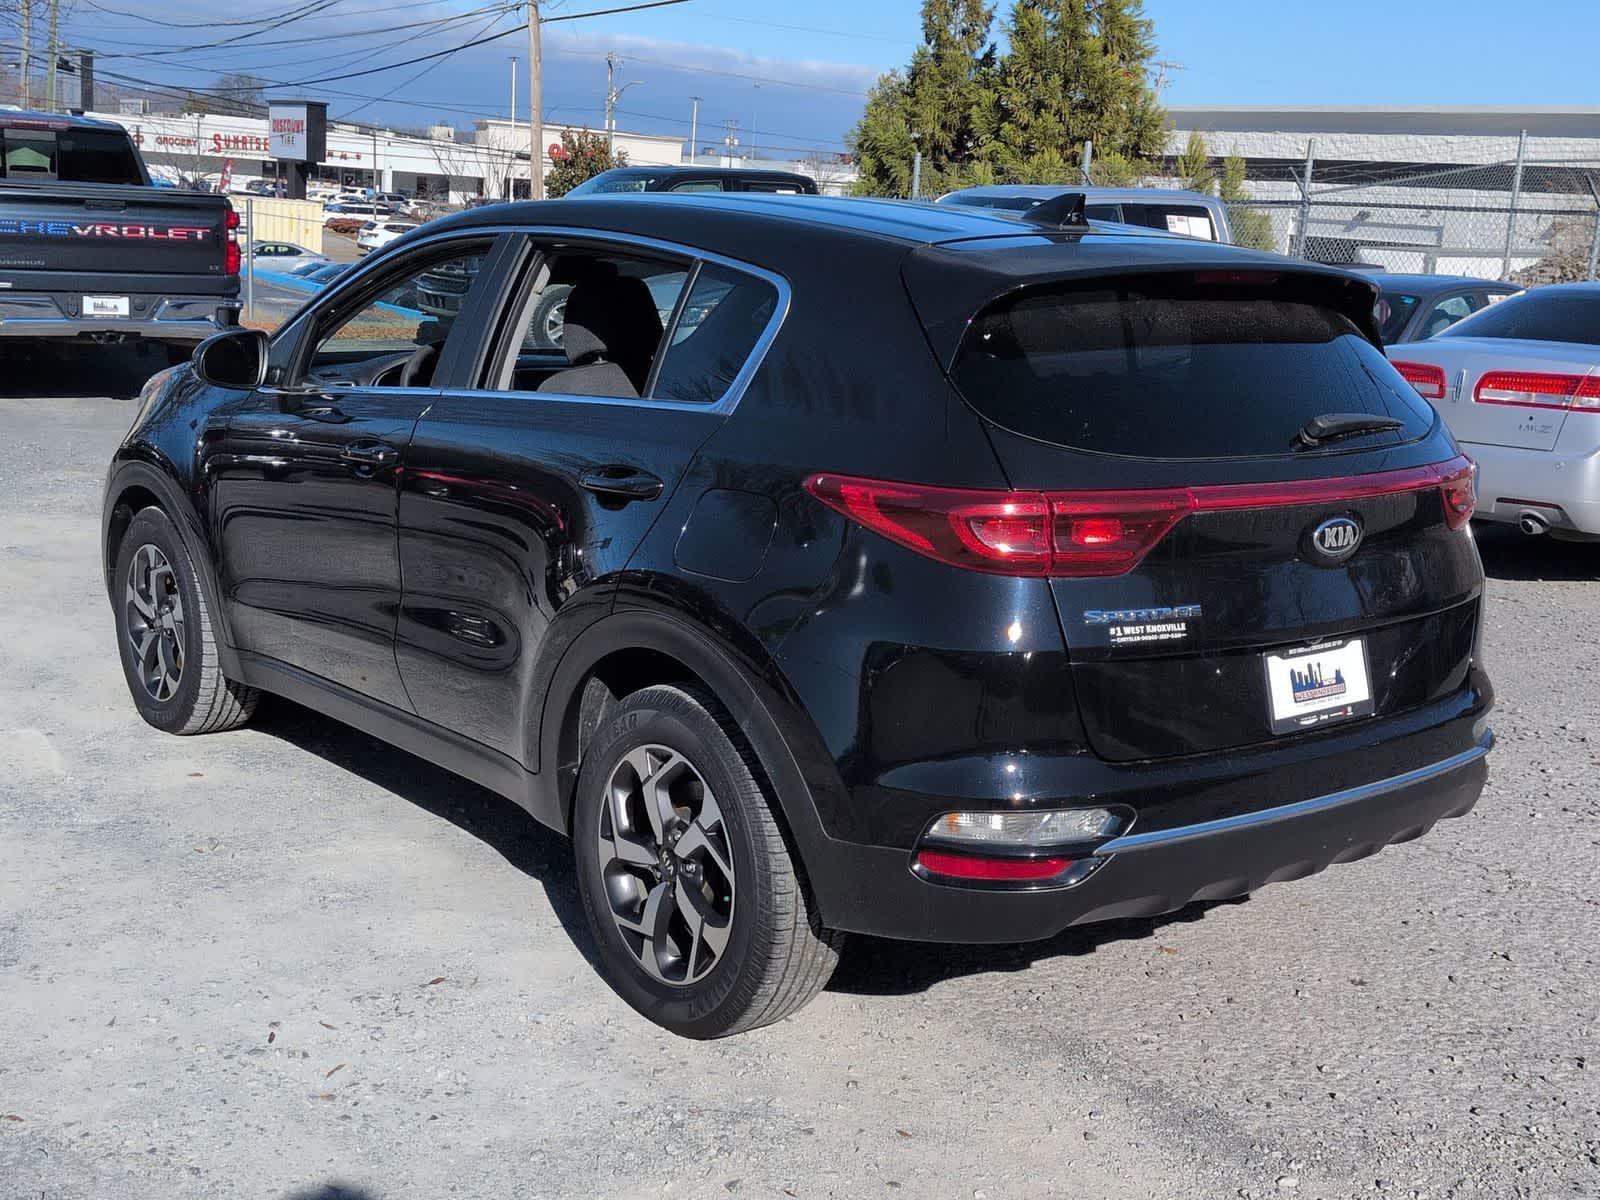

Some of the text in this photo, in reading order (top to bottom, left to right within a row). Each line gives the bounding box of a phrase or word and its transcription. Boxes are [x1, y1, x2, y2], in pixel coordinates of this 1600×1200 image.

[155, 135, 197, 147] GROCERY
[1324, 525, 1355, 548] KIA
[1123, 625, 1145, 636] WEST
[1145, 622, 1187, 634] KNOXVILLE
